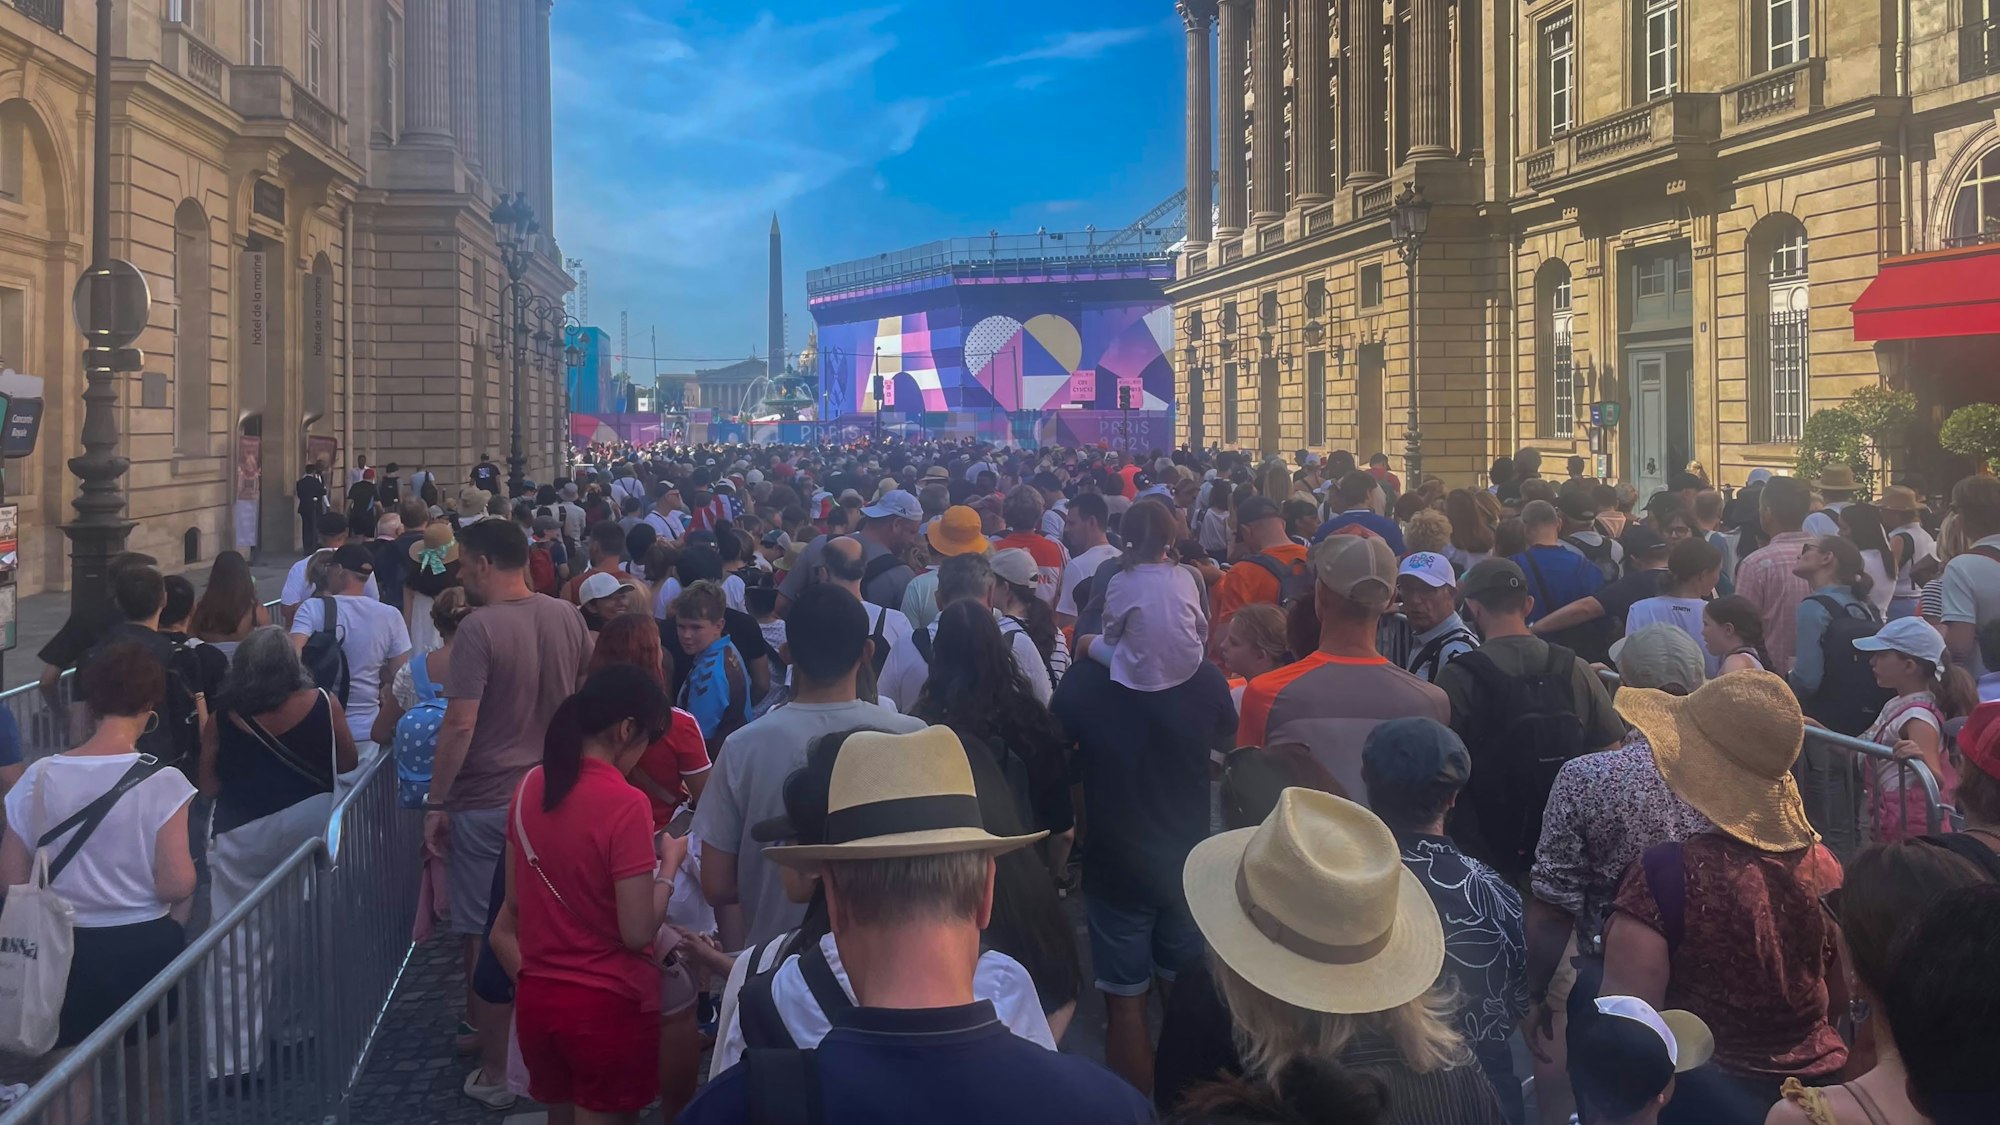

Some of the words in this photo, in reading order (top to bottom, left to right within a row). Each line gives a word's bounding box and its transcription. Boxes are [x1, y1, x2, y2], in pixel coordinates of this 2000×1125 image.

[252, 255, 262, 291] marine
[252, 293, 262, 303] la
[313, 277, 322, 308] marine
[252, 304, 262, 317] de
[313, 310, 322, 319] la
[252, 320, 262, 345] hôtel
[313, 321, 322, 331] de
[313, 332, 322, 356] hôtel
[1100, 421, 1149, 434] PARIS
